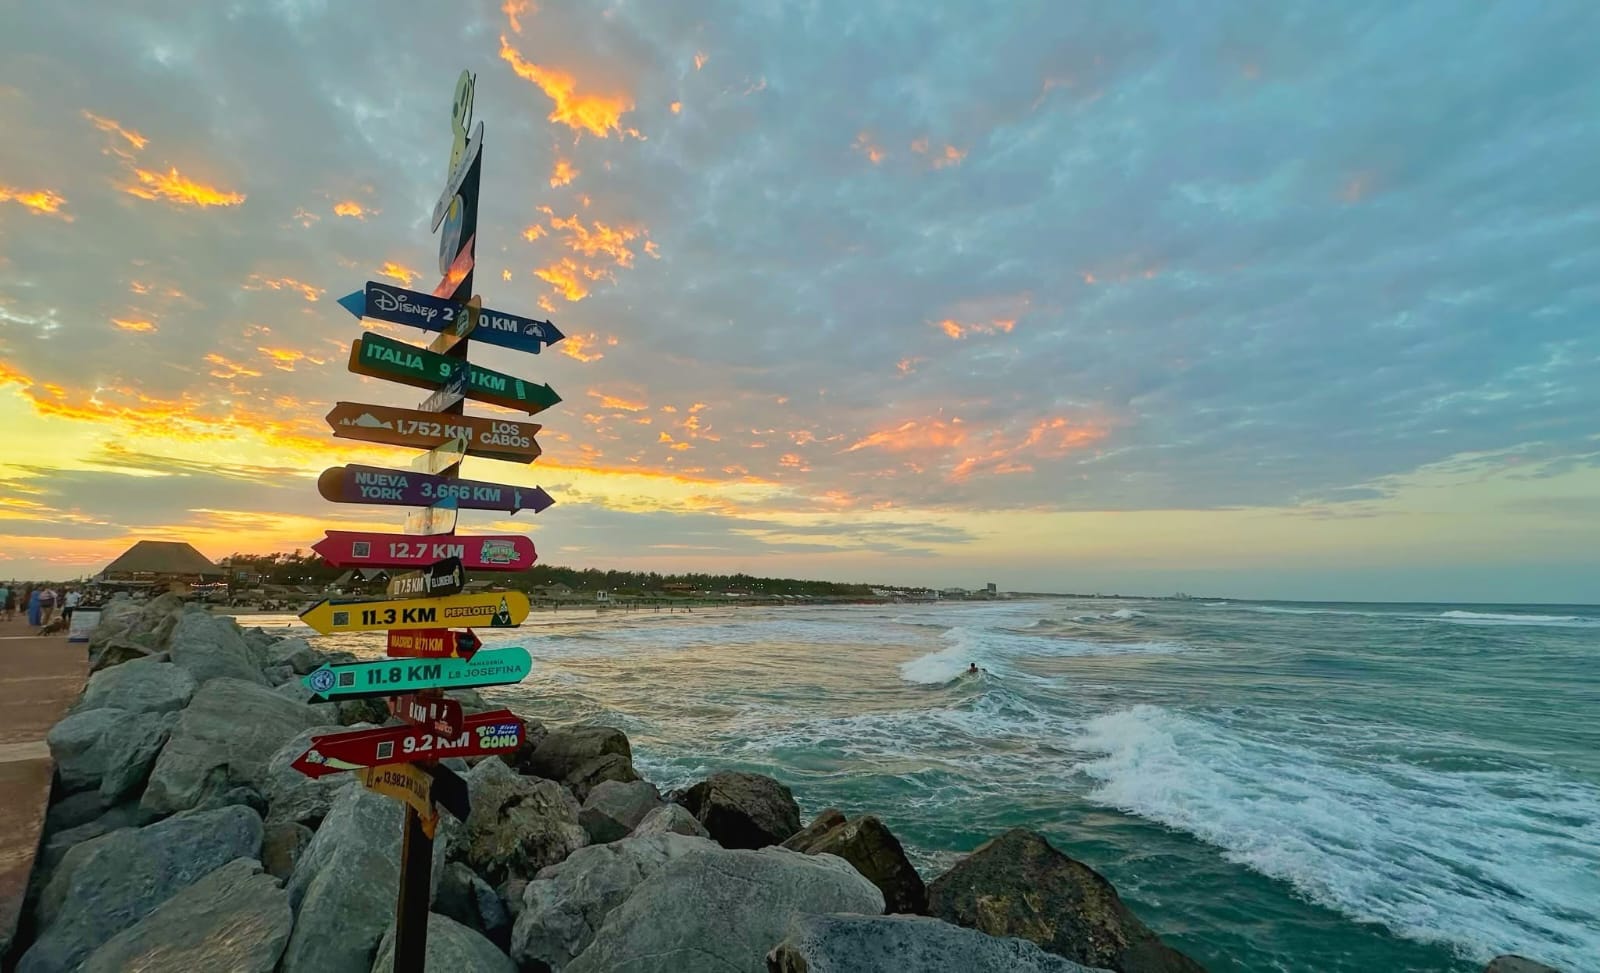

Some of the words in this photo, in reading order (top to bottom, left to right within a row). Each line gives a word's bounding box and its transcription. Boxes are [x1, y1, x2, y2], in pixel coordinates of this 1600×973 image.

[492, 316, 518, 333] KM
[366, 343, 424, 371] ITALIA
[478, 373, 506, 392] KM
[397, 419, 441, 438] 1,752
[444, 425, 473, 441] KM
[492, 421, 519, 436] LOS
[480, 432, 530, 448] CABOS
[355, 472, 408, 488] NUEVA
[360, 486, 403, 501] YORK
[420, 483, 470, 501] 3,666
[474, 486, 501, 502] KM
[389, 543, 427, 559] 12.7
[432, 544, 464, 560] KM
[401, 579, 412, 593] 7.5
[412, 577, 424, 592] KM
[362, 608, 397, 625] 11.3
[402, 607, 436, 623] KM
[444, 605, 496, 618] PEPELOTES
[429, 638, 444, 652] KM
[367, 668, 401, 685] 11.8
[408, 664, 441, 682] KM
[463, 663, 522, 679] JOSEFINA
[414, 703, 427, 723] KM
[403, 734, 433, 754] 9.2
